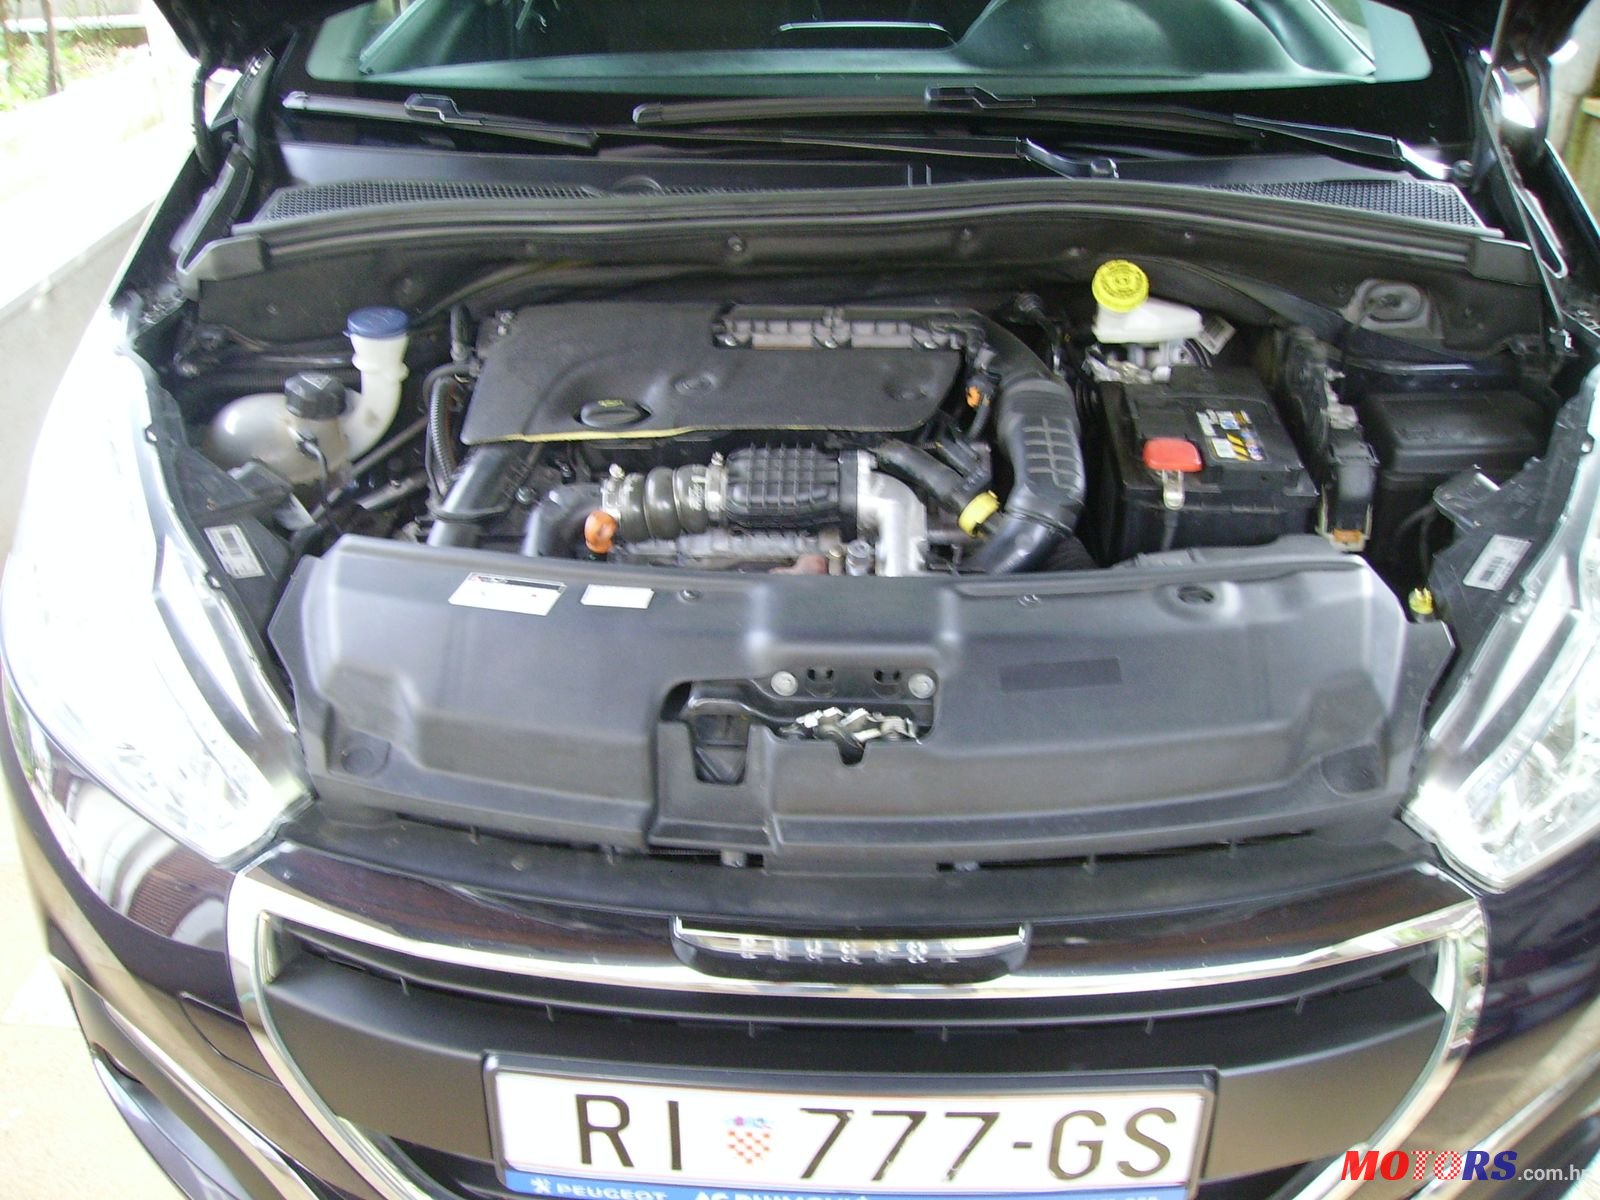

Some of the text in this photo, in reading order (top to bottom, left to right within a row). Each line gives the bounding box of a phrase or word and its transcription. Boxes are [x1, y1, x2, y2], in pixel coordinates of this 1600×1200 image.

[576, 1094, 1177, 1181] RI 777-GS
[556, 1183, 667, 1200] PEUGEOT
